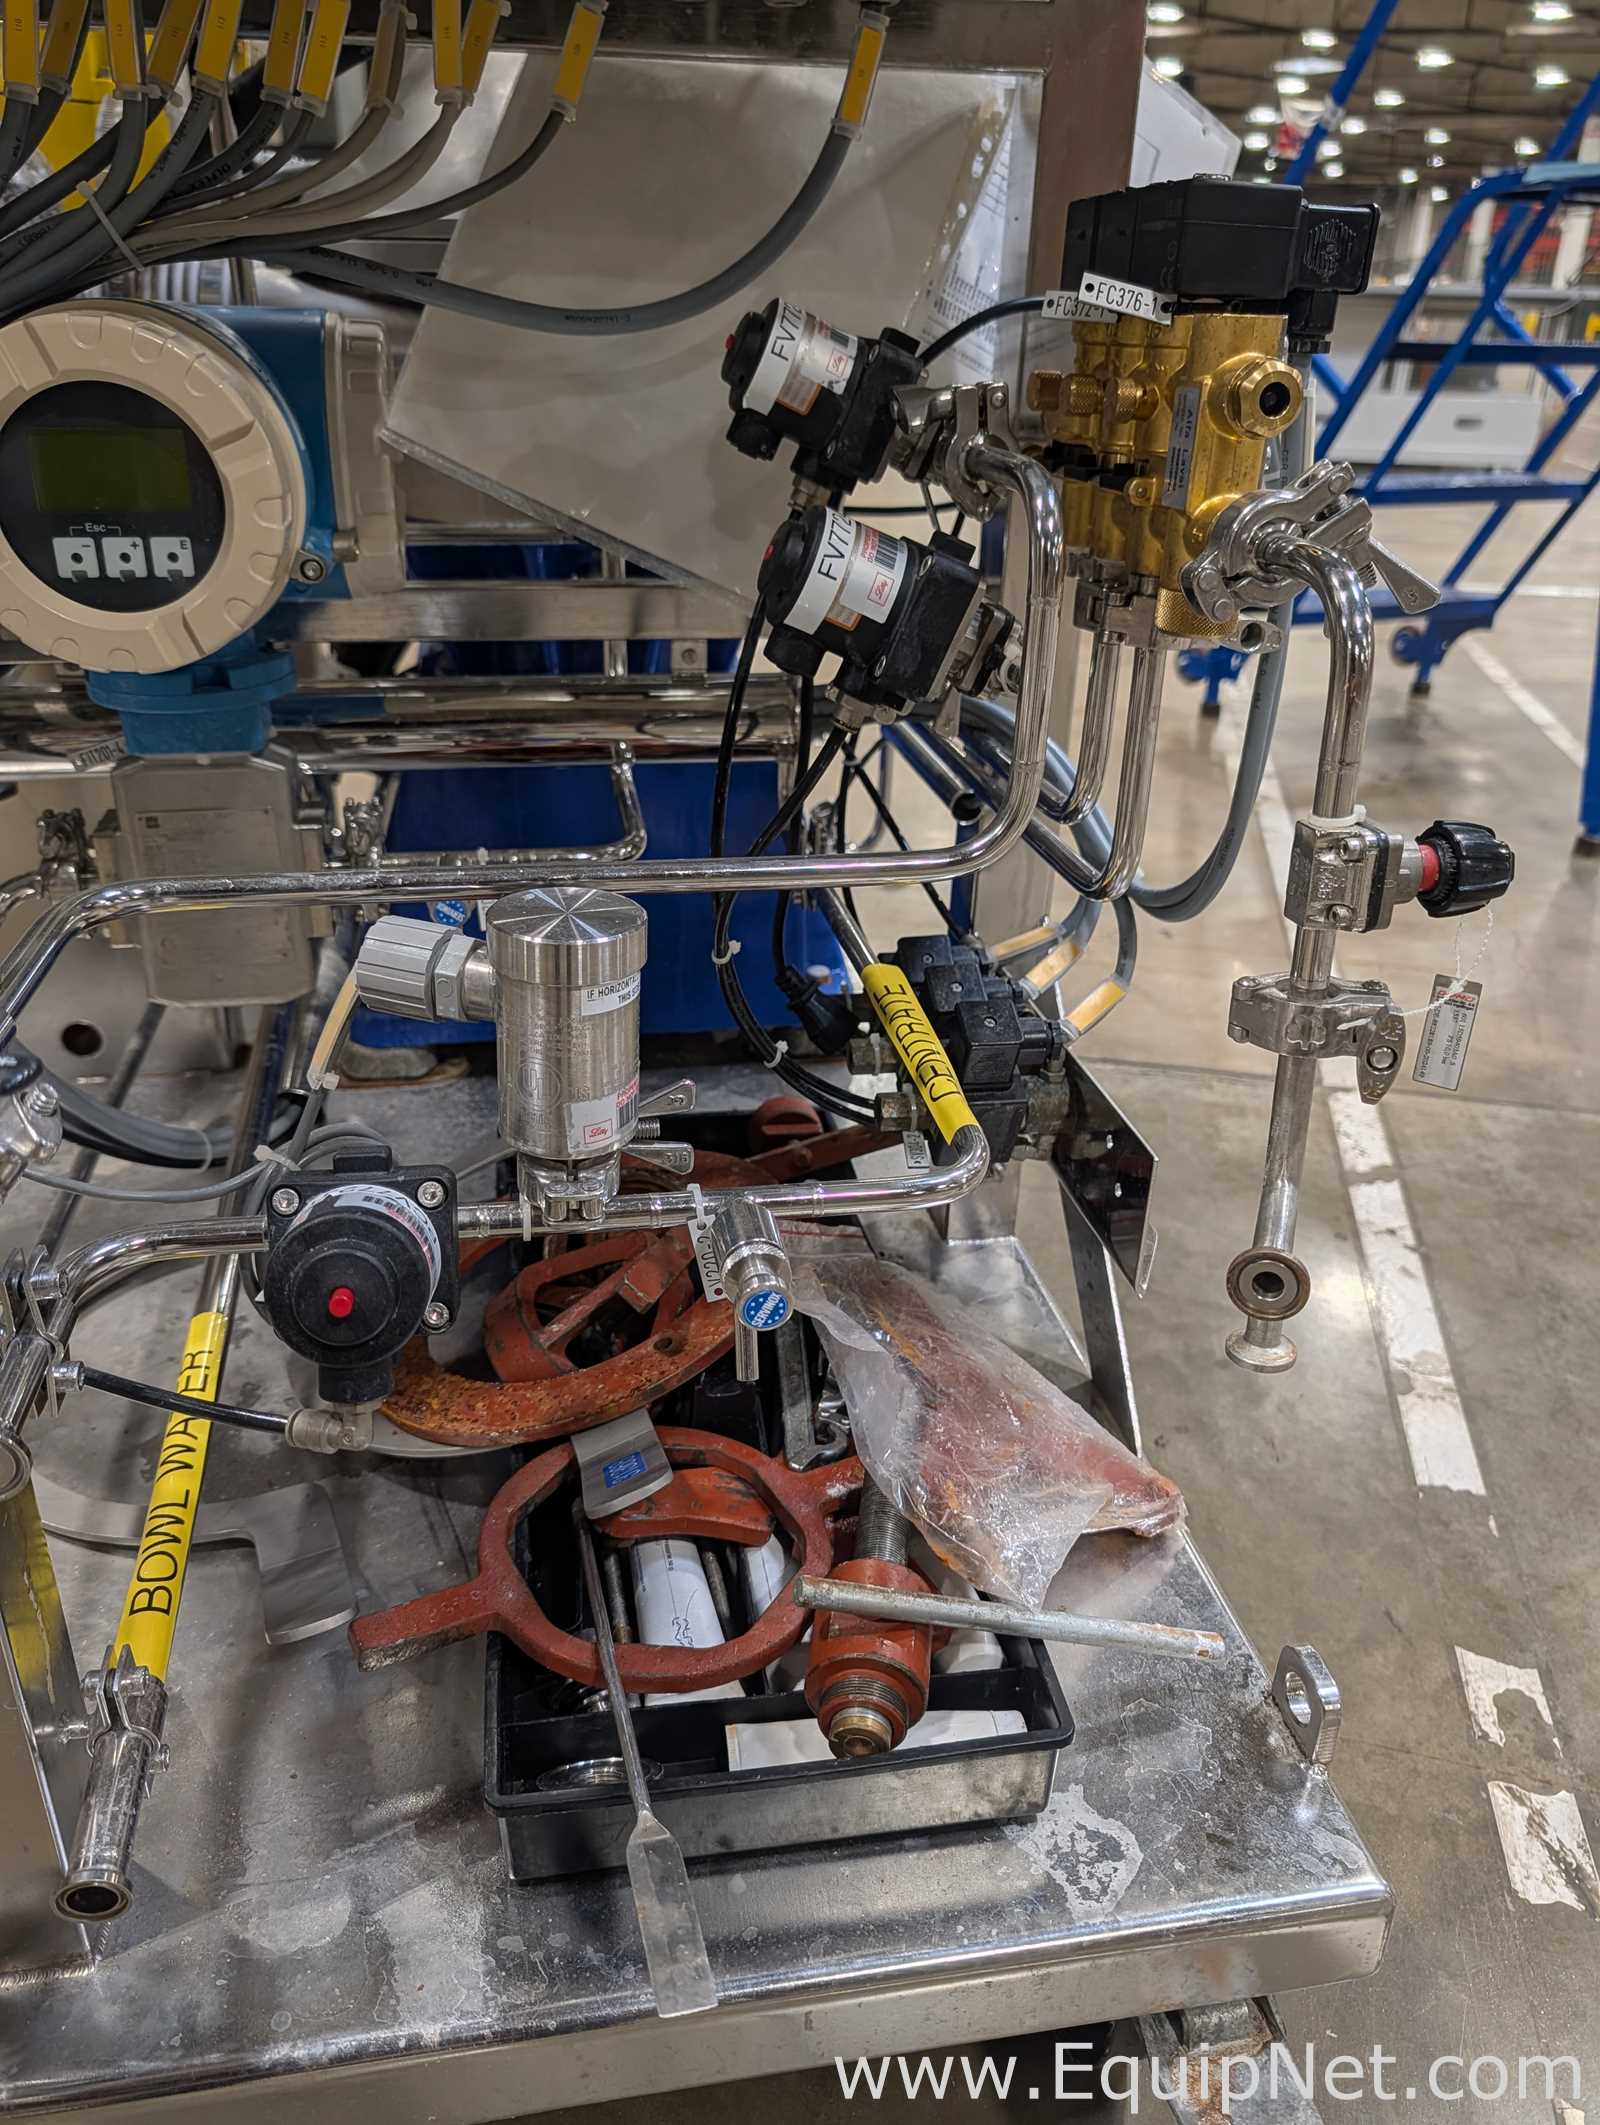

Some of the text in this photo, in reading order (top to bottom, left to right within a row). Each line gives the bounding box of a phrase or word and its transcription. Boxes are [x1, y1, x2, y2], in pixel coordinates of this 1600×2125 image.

[1096, 281, 1158, 316] FC376-1
[84, 522, 107, 533] Esc
[179, 539, 189, 550] E
[587, 989, 595, 999] IF
[873, 984, 961, 1103] CENTRATE
[697, 1235, 720, 1288] V220-2
[752, 1291, 781, 1327] SERVINOX
[129, 1350, 213, 1616] BOWL WAER
